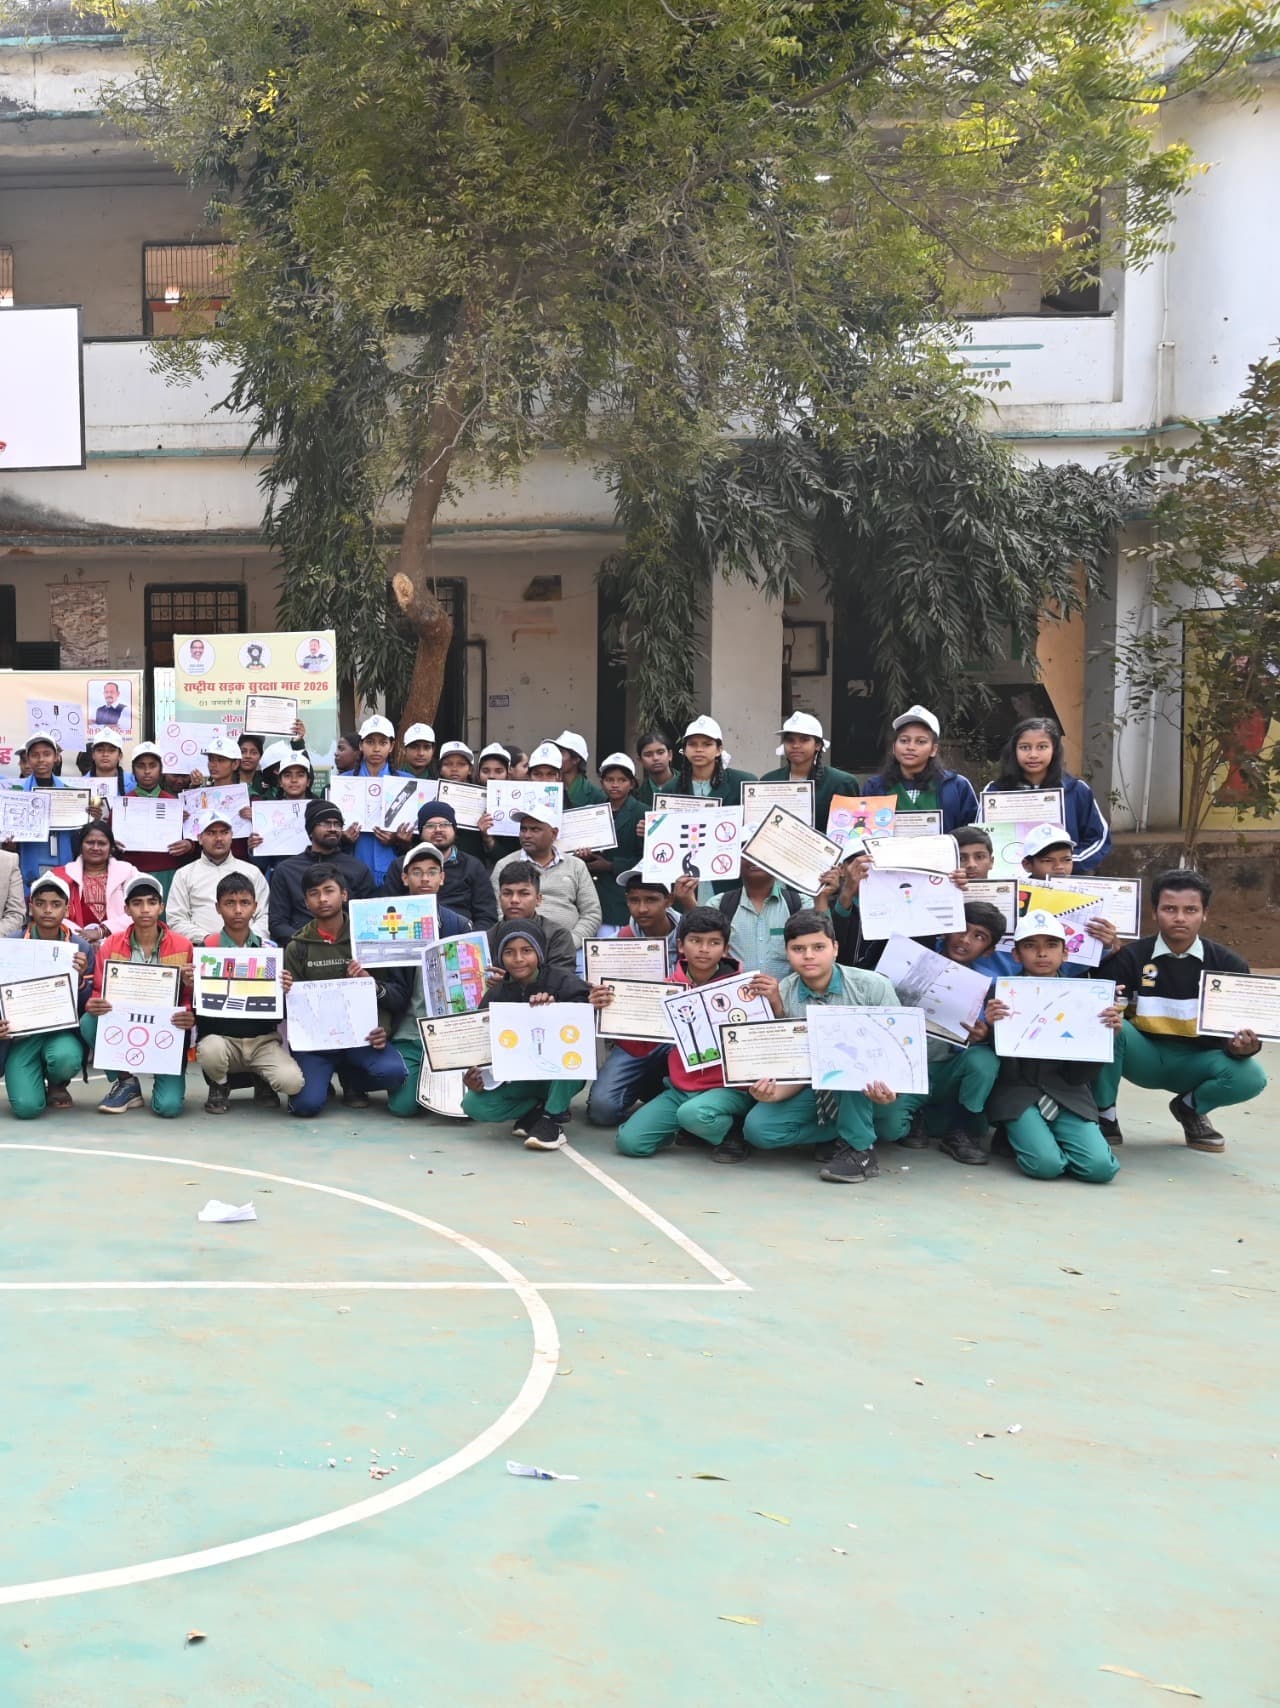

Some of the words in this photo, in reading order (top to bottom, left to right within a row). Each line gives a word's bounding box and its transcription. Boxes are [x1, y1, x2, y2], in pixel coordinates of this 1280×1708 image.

[184, 680, 216, 694] राष्ट्रीय
[219, 682, 245, 694] सड़क
[248, 681, 278, 694] सुरक्षा
[281, 681, 301, 691] माह
[304, 681, 329, 691] 2026
[1141, 963, 1158, 988] 2
